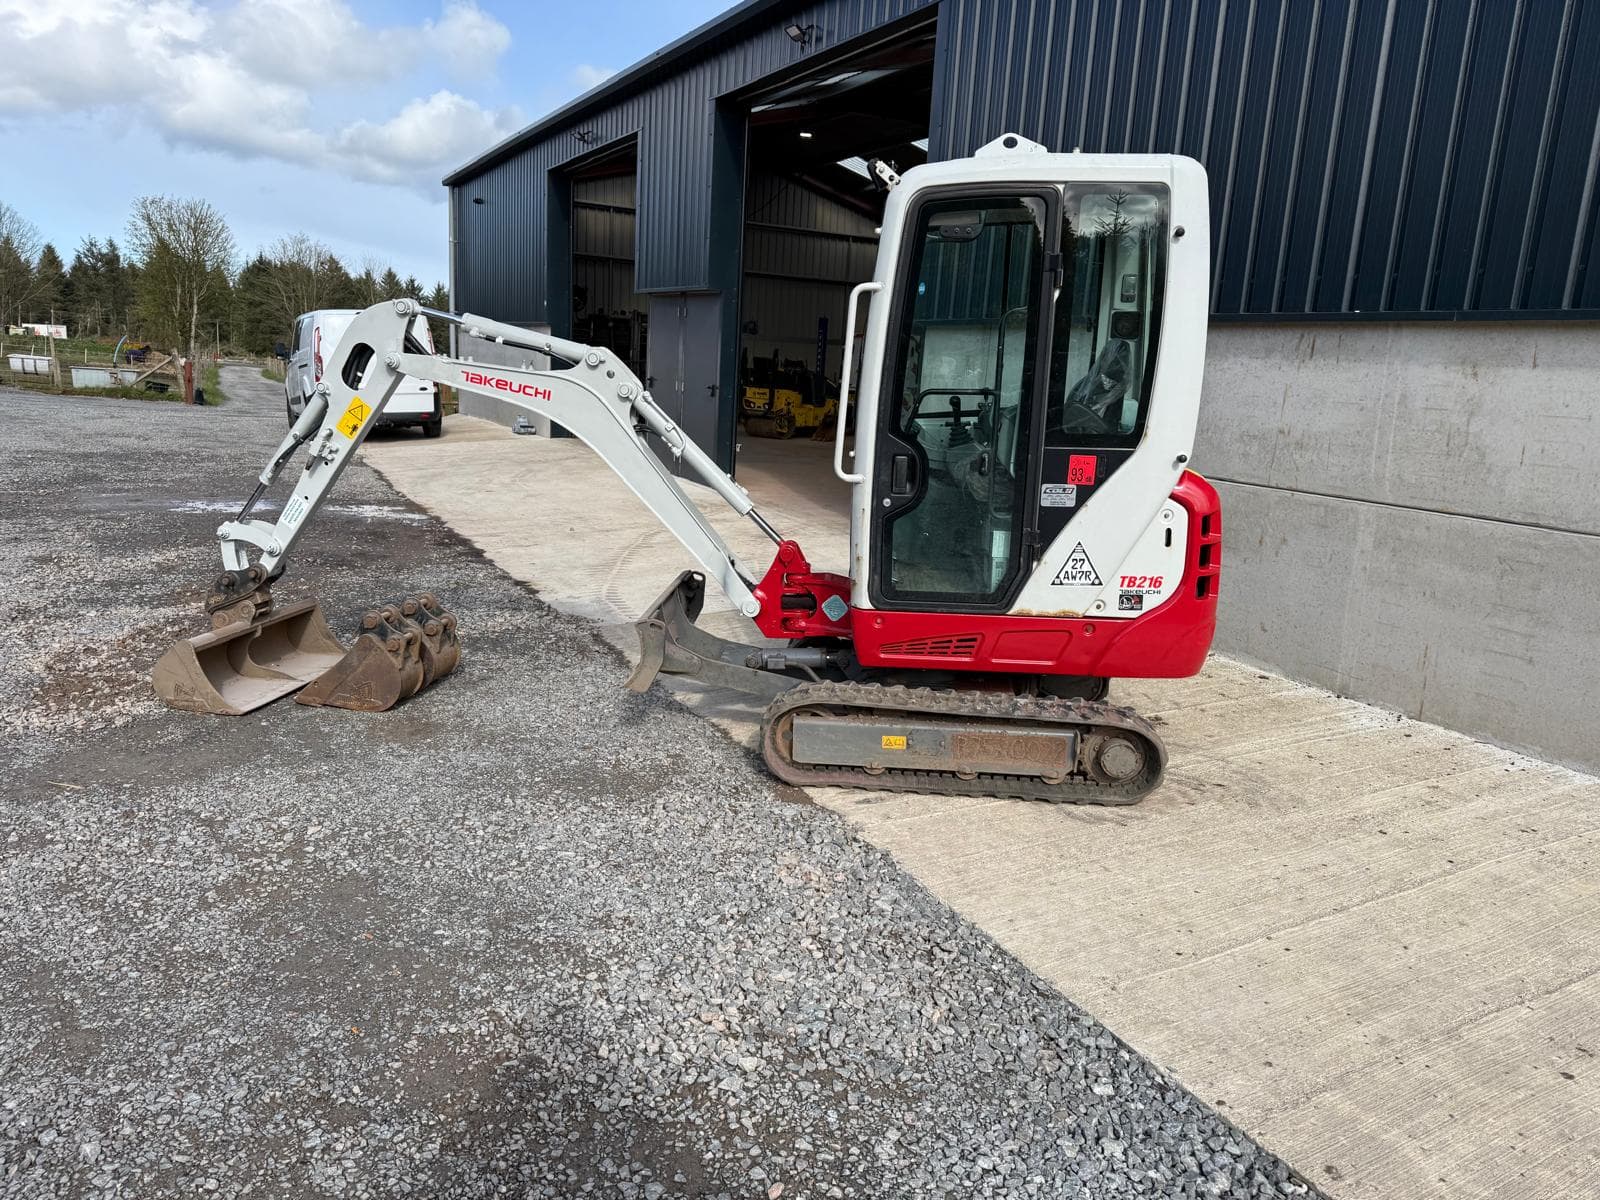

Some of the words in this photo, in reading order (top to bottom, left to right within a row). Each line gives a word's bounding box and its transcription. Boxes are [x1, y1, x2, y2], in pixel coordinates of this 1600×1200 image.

[461, 370, 552, 401] TAKEUCHI
[1070, 467, 1084, 482] 93
[1071, 558, 1085, 570] 27
[1063, 570, 1092, 582] AW7R
[1119, 575, 1164, 588] TB216
